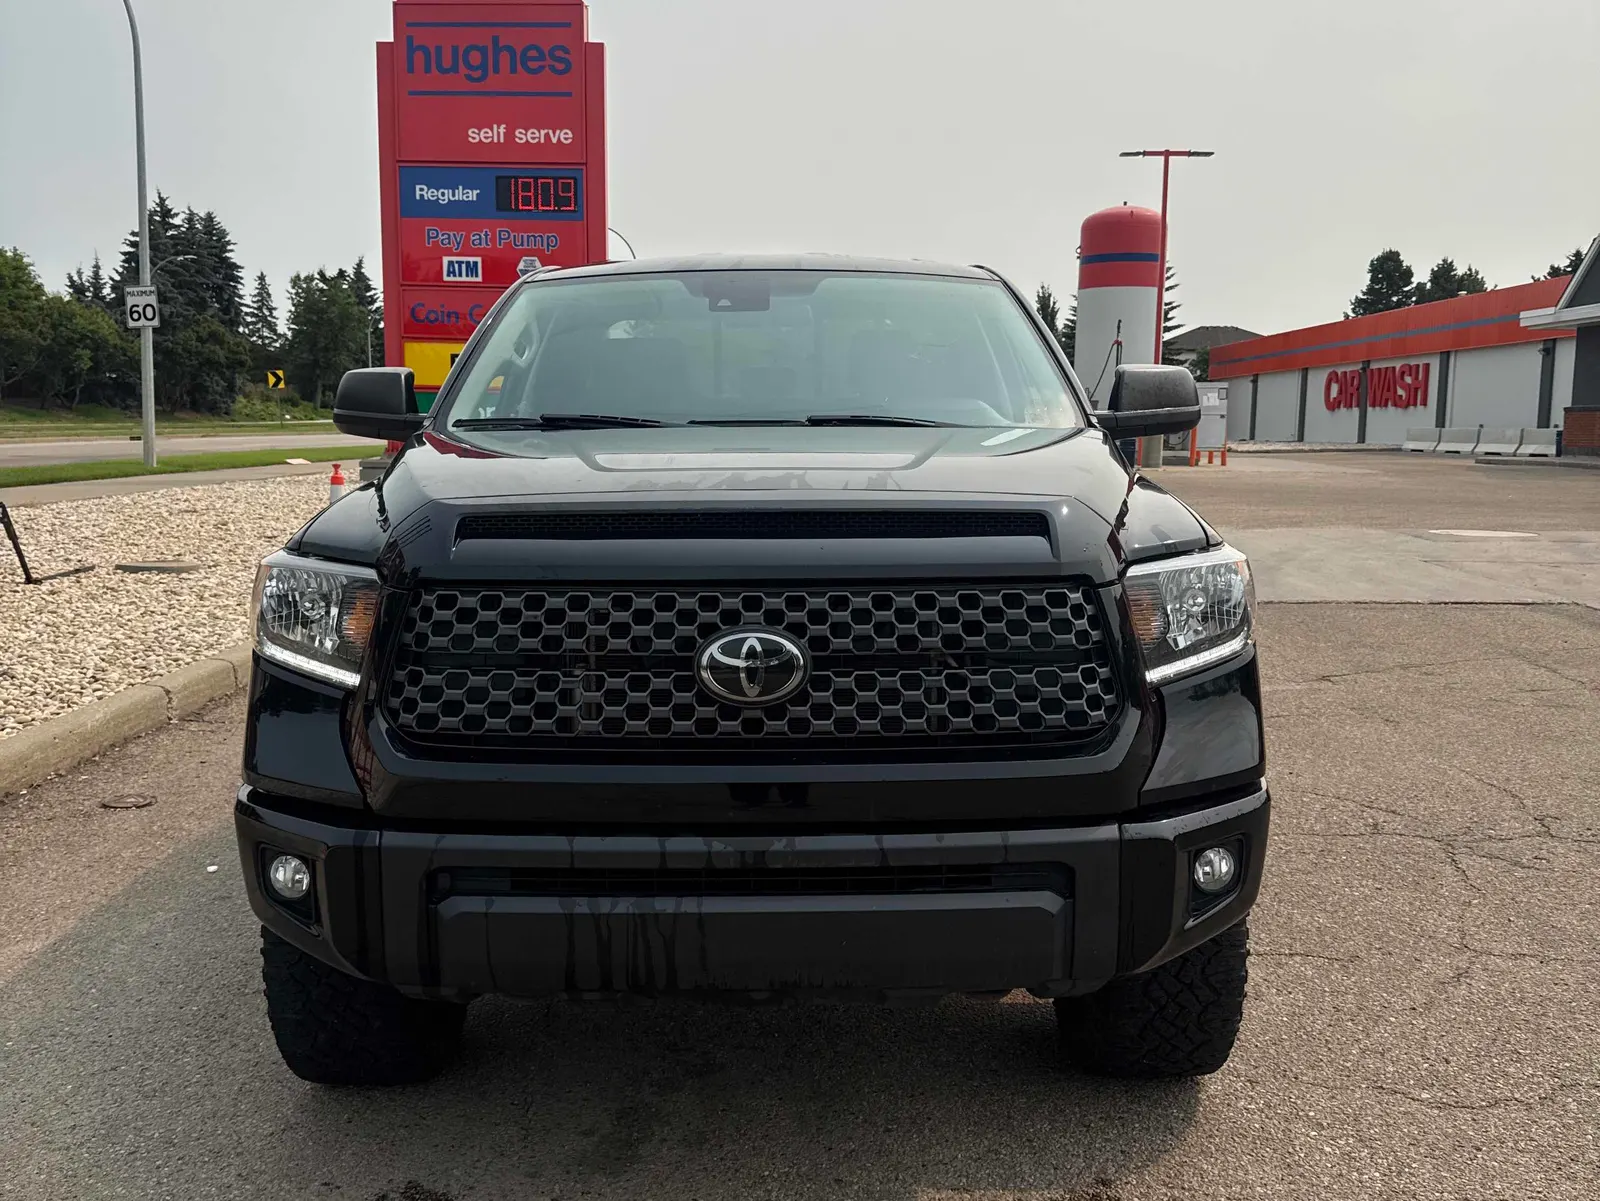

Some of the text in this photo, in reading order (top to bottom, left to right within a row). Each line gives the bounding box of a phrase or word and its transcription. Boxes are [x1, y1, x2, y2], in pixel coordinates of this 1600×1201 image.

[406, 35, 573, 83] hughes
[467, 124, 574, 144] self serve
[415, 184, 480, 204] Regular
[425, 227, 559, 253] Pay at Pump
[446, 260, 479, 278] ATM
[126, 289, 155, 298] MAXIMUM
[129, 303, 156, 322] 60
[410, 302, 483, 326] Coin C
[1324, 363, 1430, 412] CAR WASH
